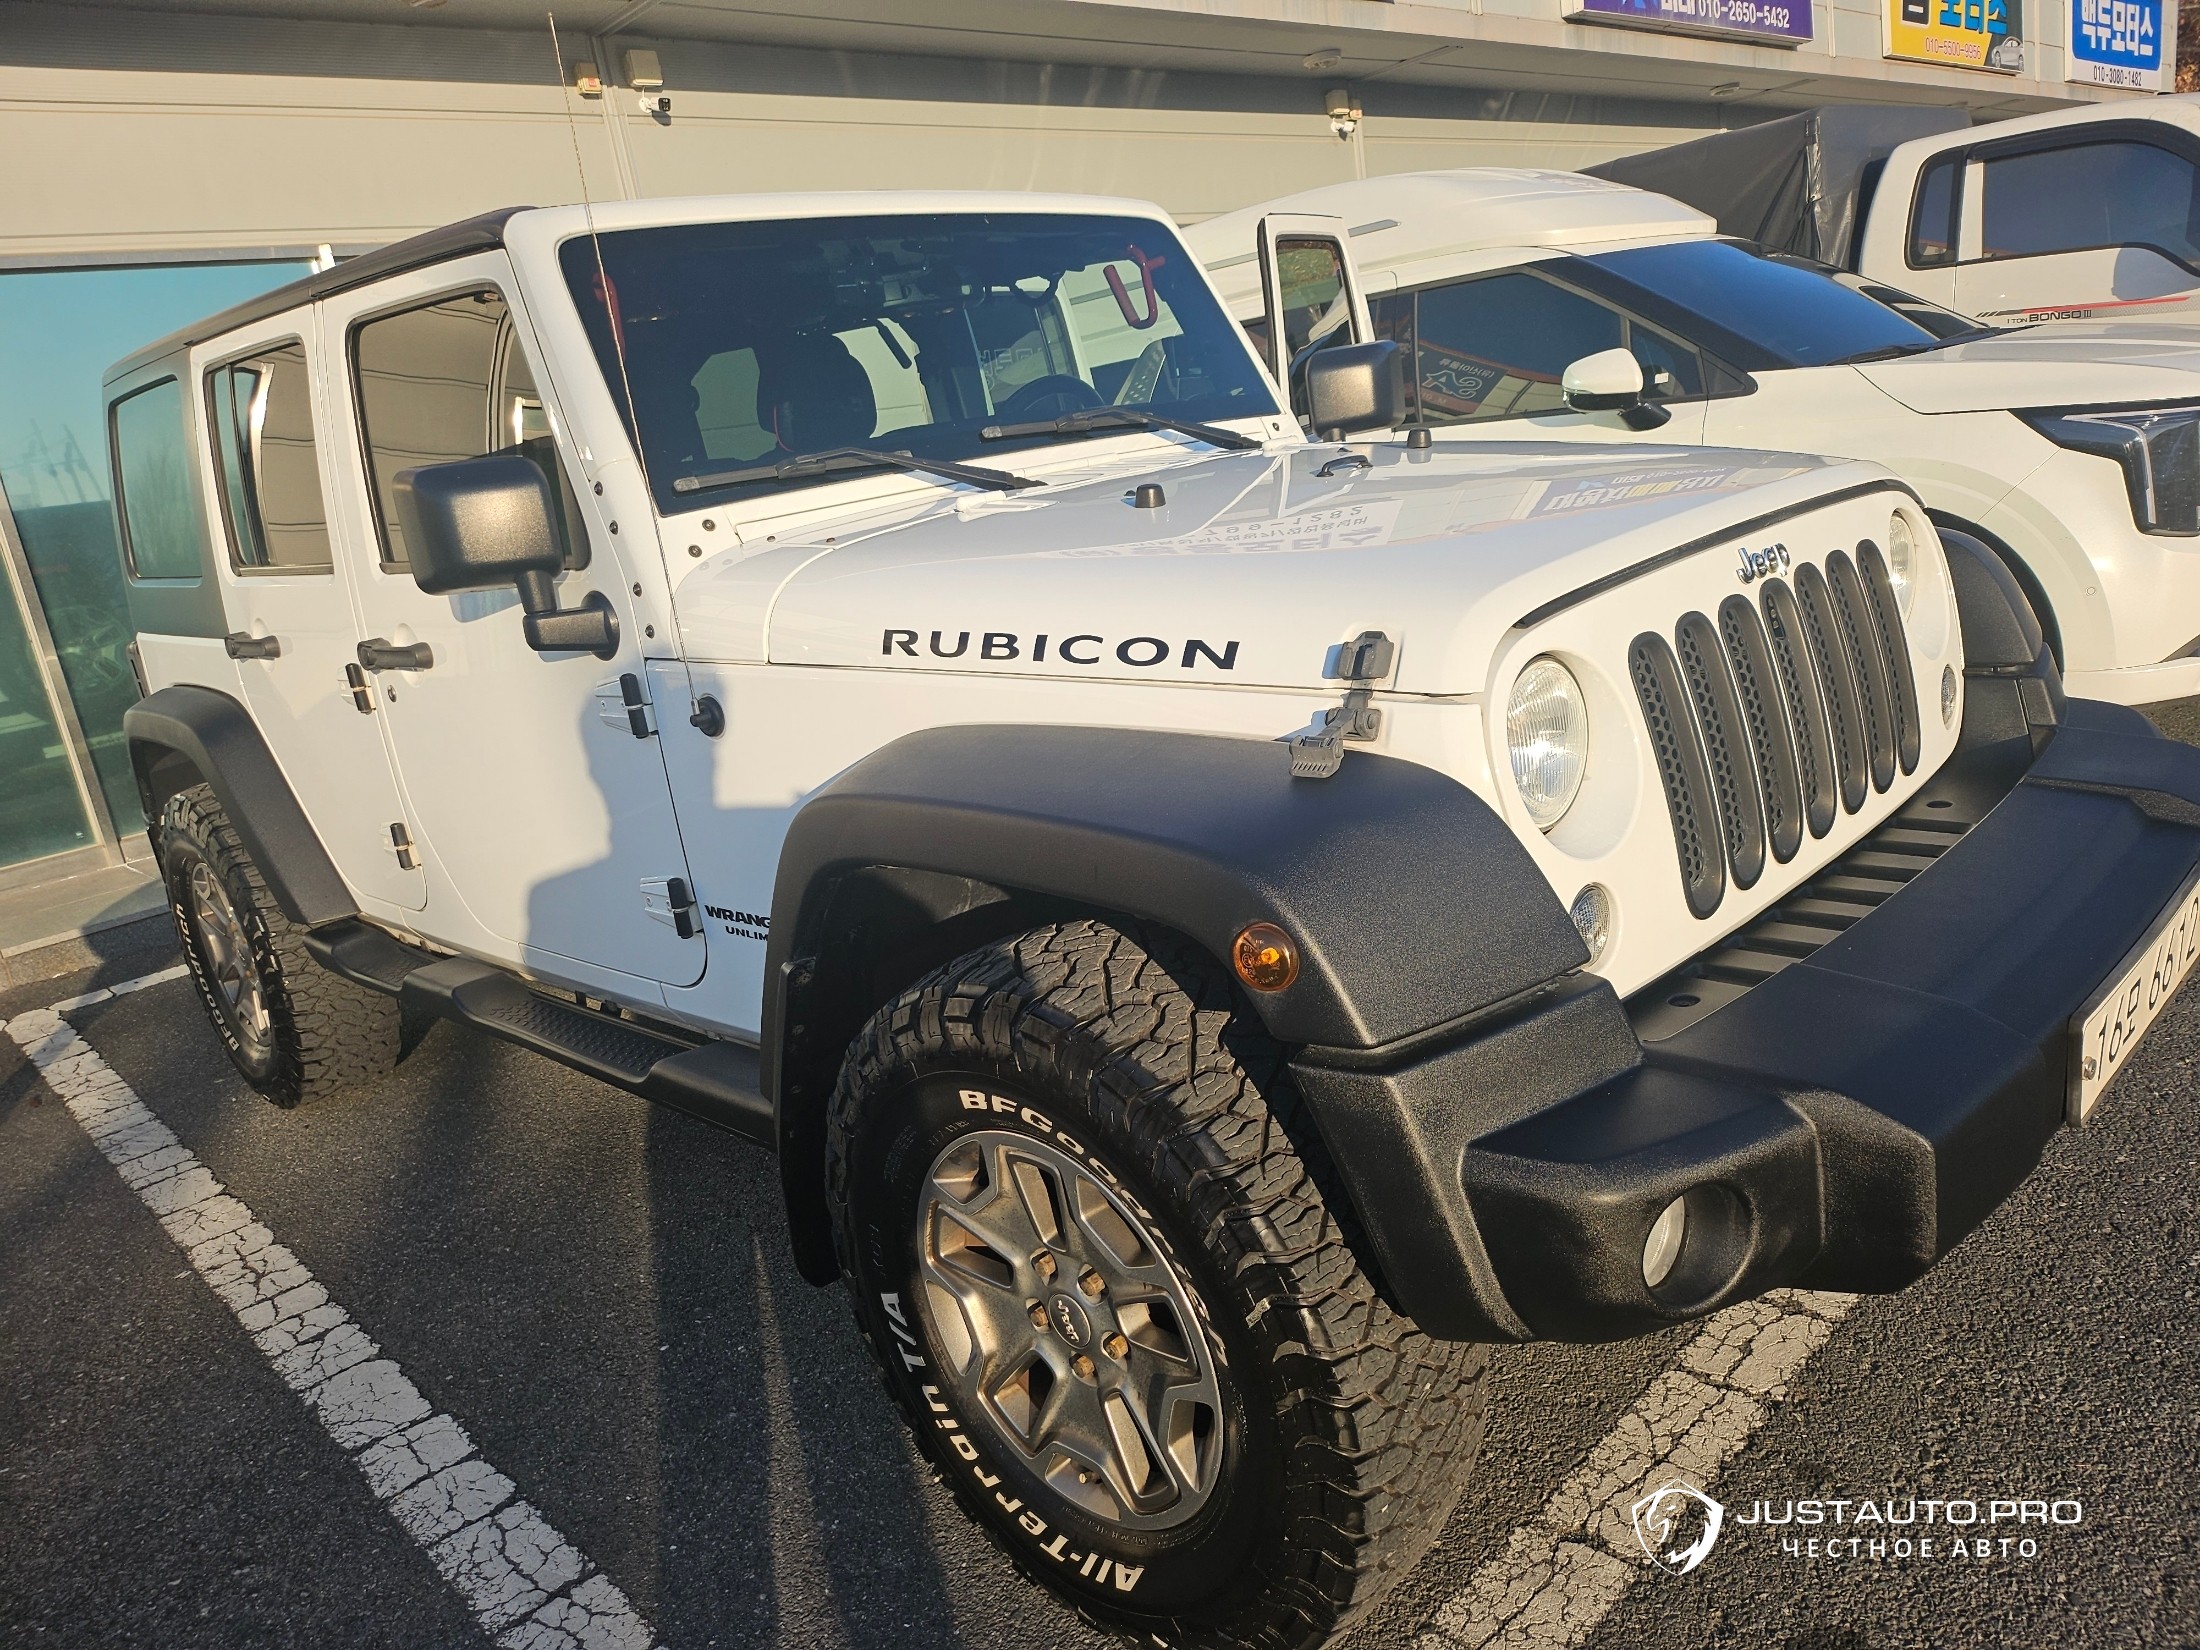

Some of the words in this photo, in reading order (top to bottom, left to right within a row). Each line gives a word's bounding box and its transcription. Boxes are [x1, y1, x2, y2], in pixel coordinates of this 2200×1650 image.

[2029, 310, 2082, 322] BONGO
[1736, 543, 1790, 585] Jeep
[882, 629, 1240, 670] RUBICON
[2149, 896, 2199, 1012] 6612
[880, 1292, 927, 1373] T/A
[1057, 1299, 1080, 1342] Jeep
[921, 1384, 1146, 1593] All-Terrain
